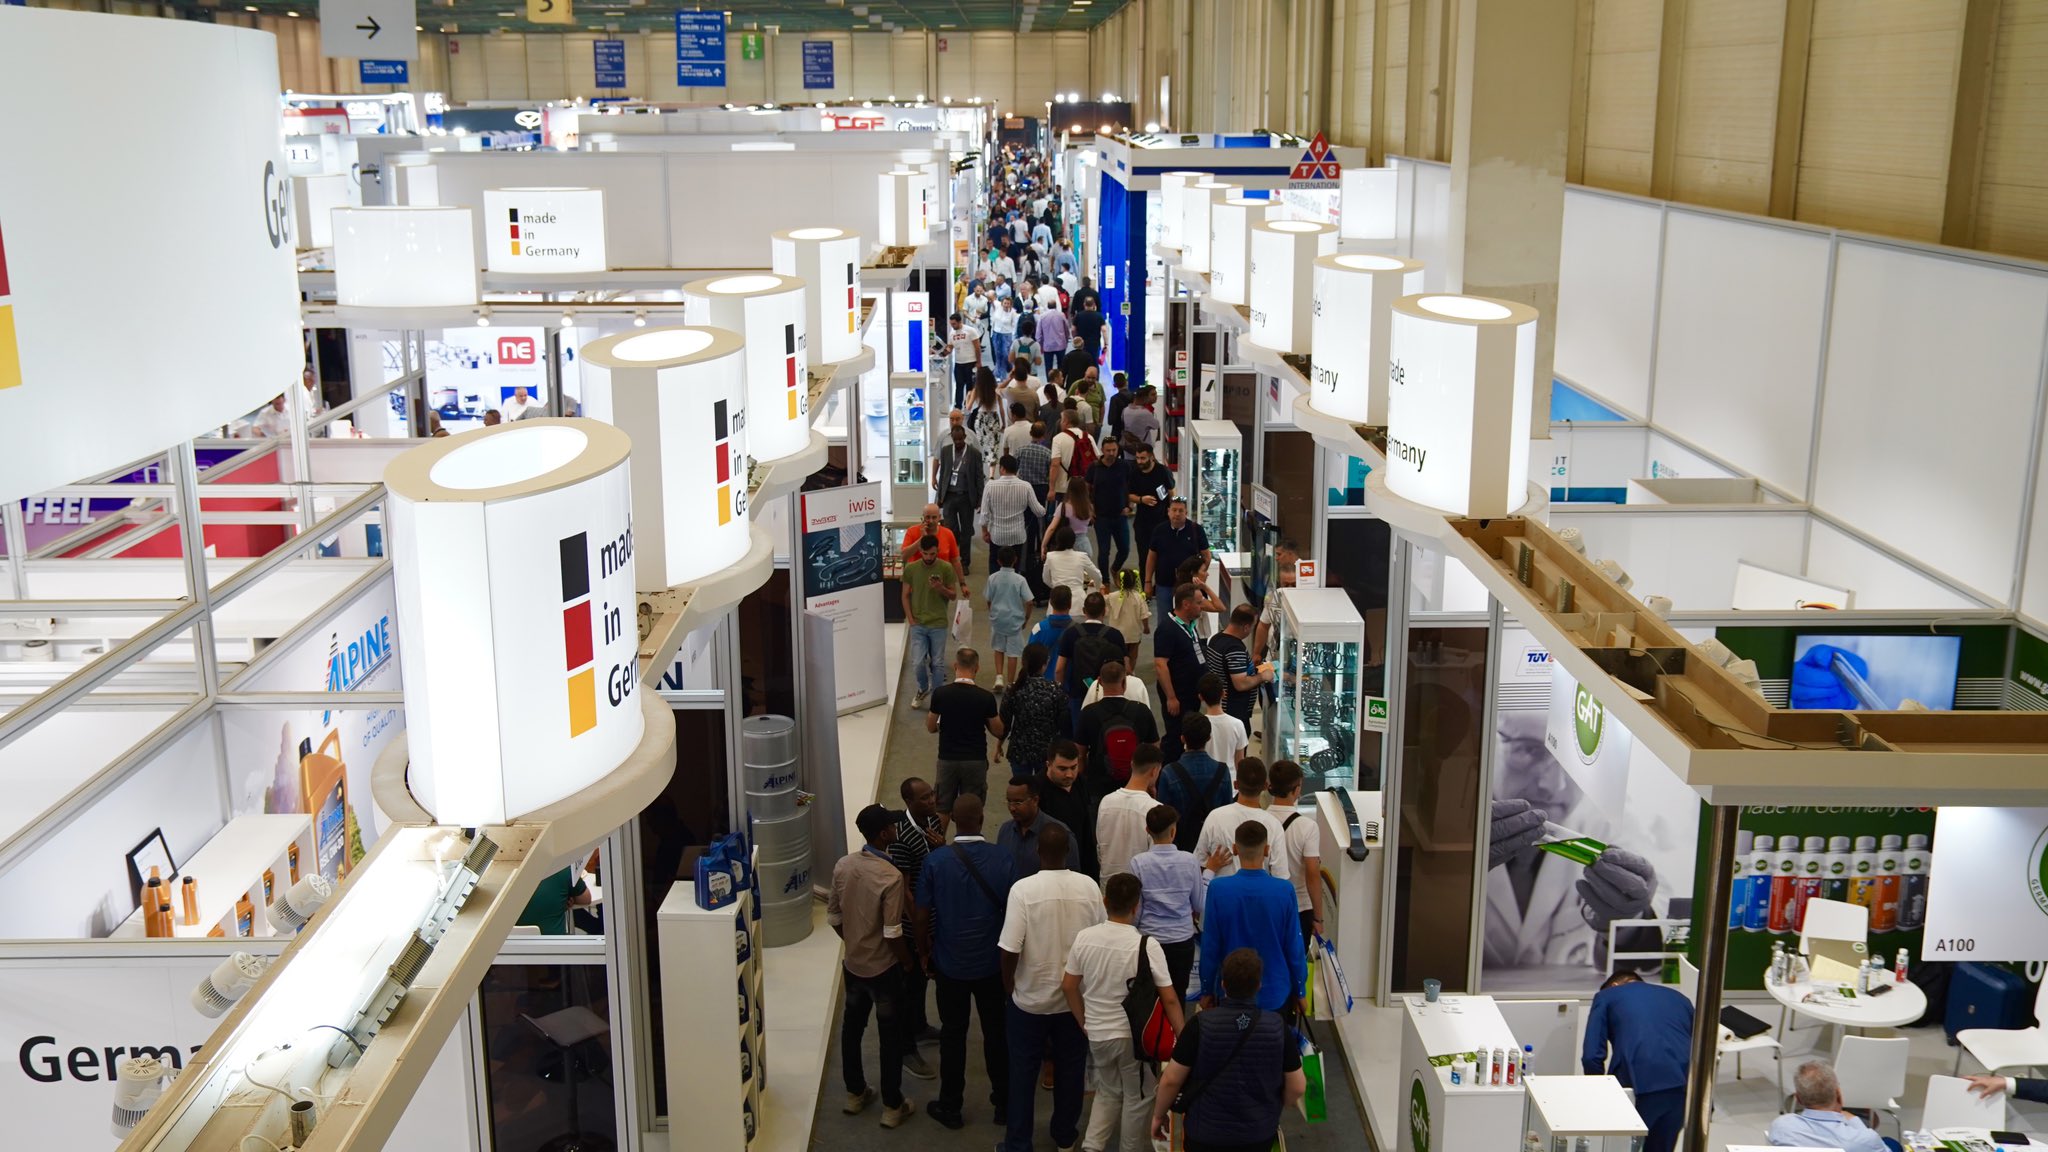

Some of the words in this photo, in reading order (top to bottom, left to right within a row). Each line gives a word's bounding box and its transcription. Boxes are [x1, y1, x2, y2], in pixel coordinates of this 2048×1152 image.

[523, 212, 557, 224] made
[524, 229, 535, 240] in
[525, 245, 580, 258] Germany
[734, 449, 742, 476] in
[26, 497, 97, 524] FEEL
[848, 497, 875, 513] iwis
[604, 601, 621, 645] in
[323, 615, 391, 728] ALPINE
[372, 709, 397, 739] QUALITY
[1577, 690, 1602, 734] GAT
[1936, 938, 1976, 952] A100
[1411, 1098, 1429, 1149] GAT
